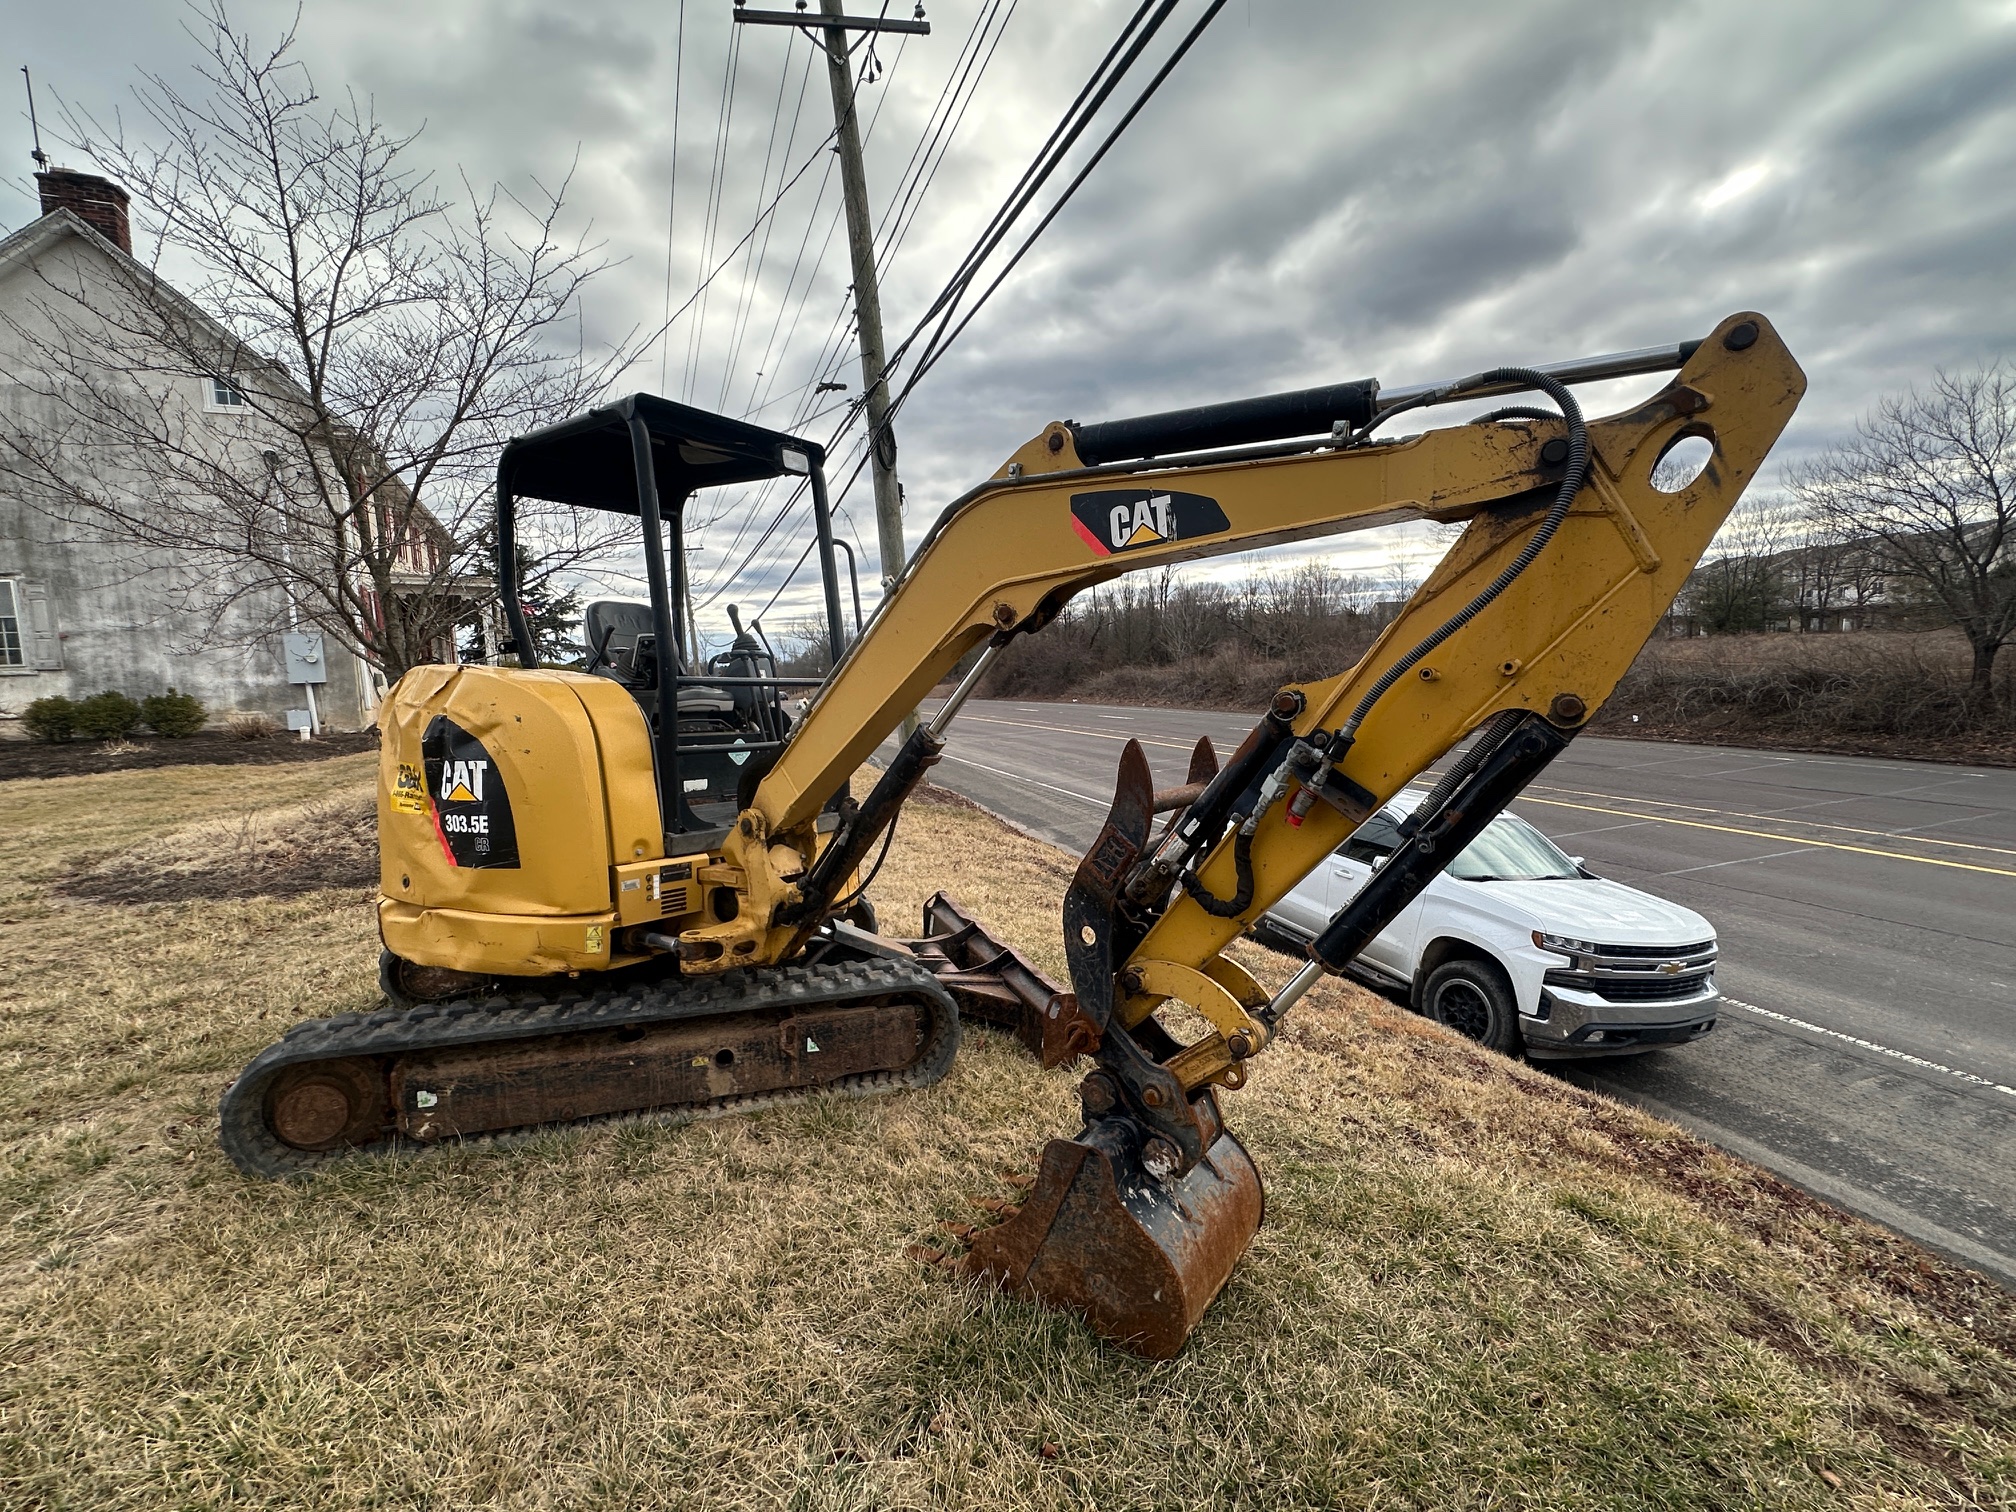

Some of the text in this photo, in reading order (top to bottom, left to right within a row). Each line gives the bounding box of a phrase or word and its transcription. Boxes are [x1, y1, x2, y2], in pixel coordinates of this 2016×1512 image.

[1110, 494, 1171, 548] CAT
[441, 760, 488, 801] CAT
[445, 814, 489, 834] 303.5E
[474, 837, 490, 852] CR
